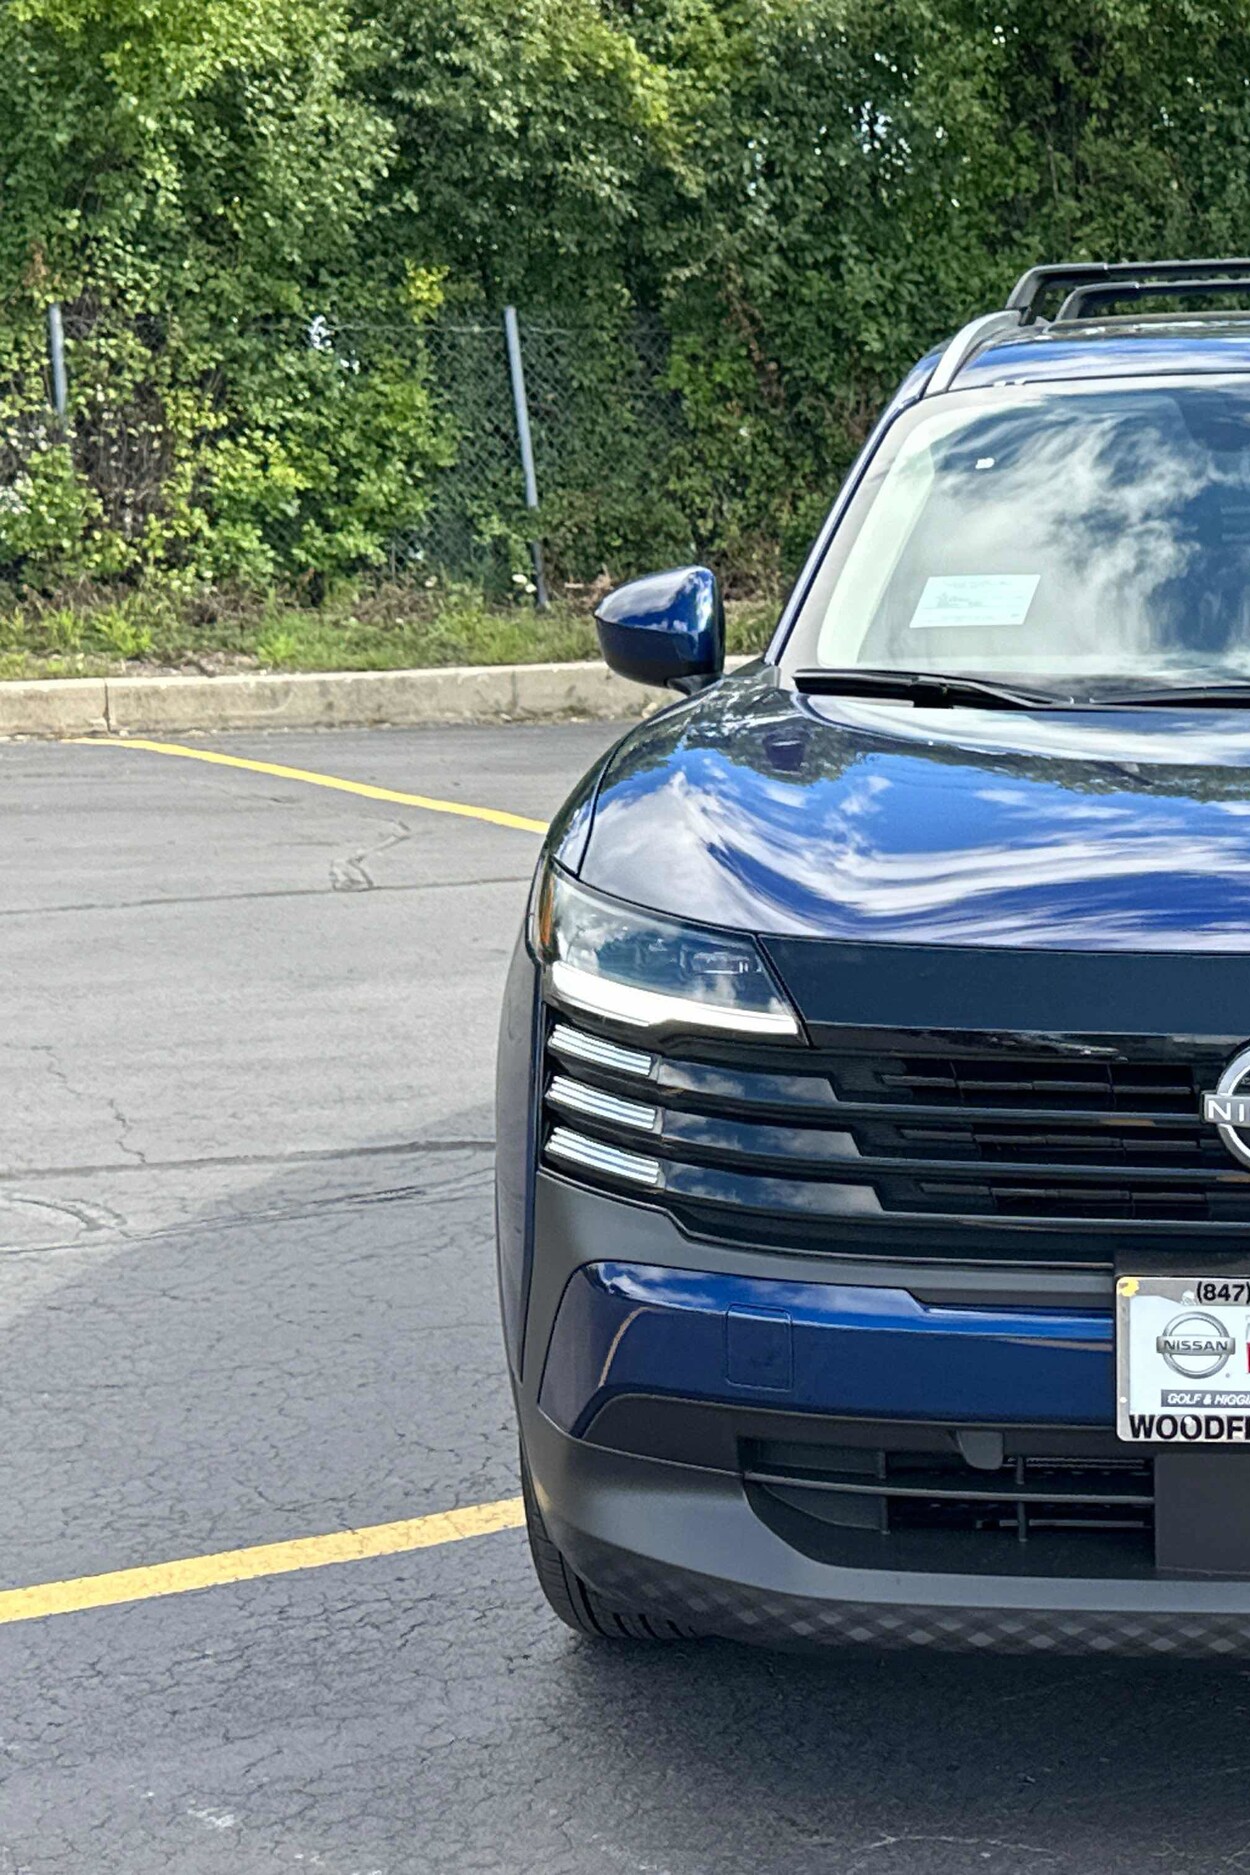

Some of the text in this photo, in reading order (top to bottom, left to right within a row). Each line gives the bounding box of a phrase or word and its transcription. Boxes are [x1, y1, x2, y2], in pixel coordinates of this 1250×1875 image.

[1196, 1281, 1250, 1305] (847)
[1163, 1340, 1228, 1352] NISSAN
[1167, 1393, 1202, 1405] GOLF
[1205, 1394, 1212, 1405] &
